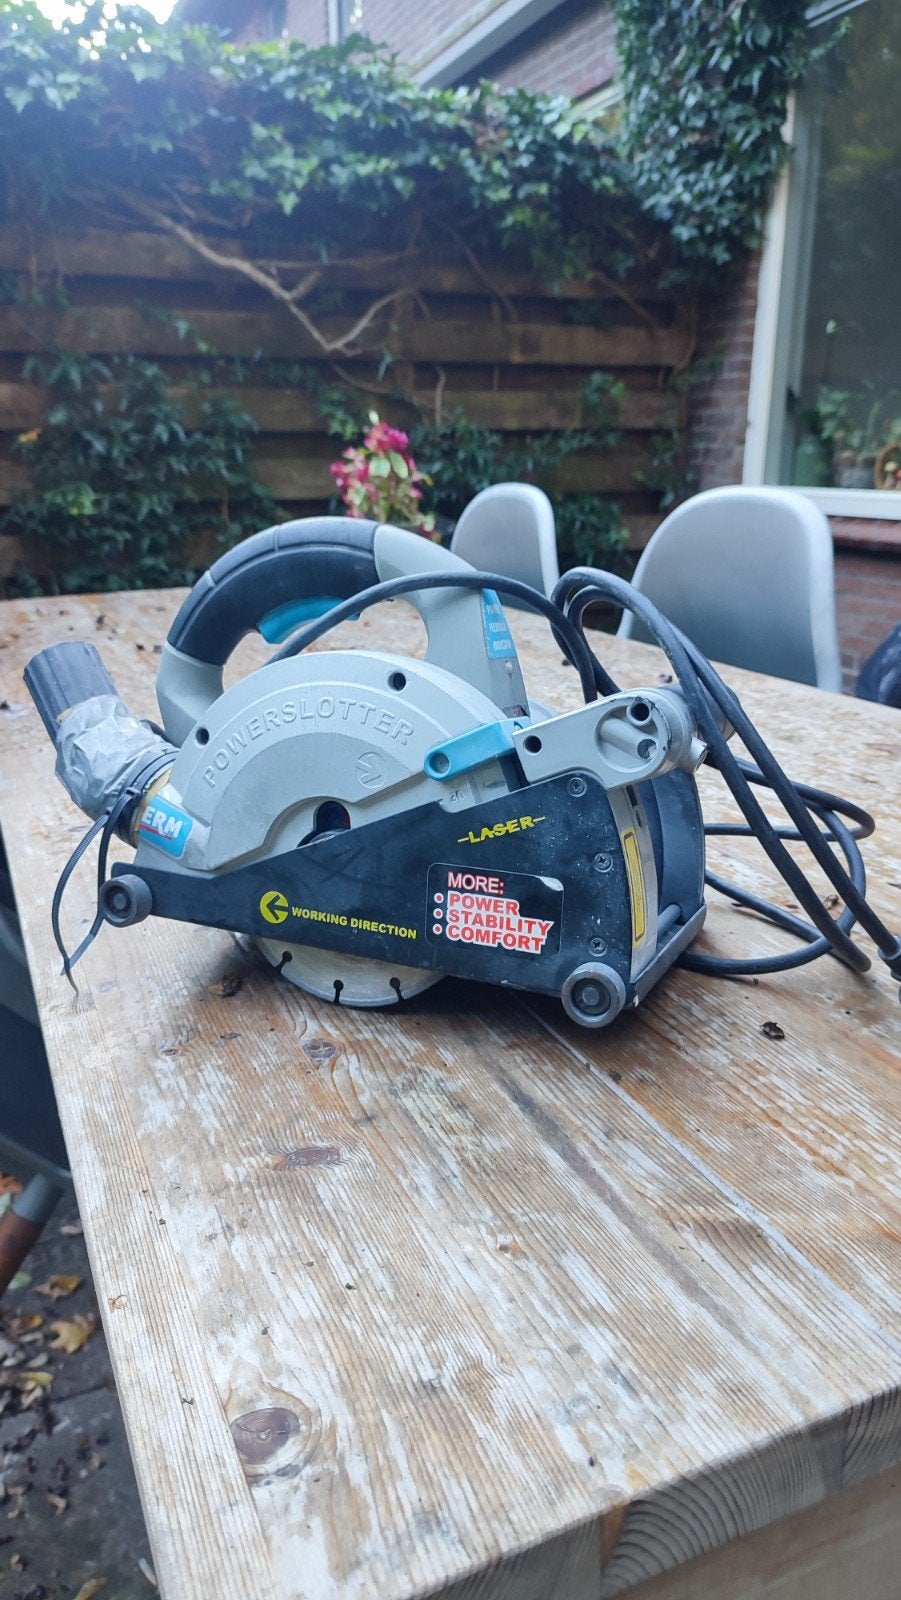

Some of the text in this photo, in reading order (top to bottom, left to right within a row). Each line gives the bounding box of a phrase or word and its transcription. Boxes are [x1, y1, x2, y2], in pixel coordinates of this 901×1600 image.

[202, 696, 414, 789] POWERSLOTTER
[141, 805, 184, 838] ERM
[468, 815, 535, 844] LASER
[447, 871, 505, 895] MORE:
[449, 892, 519, 917] POWER
[292, 906, 417, 940] WORKING DIRECTION
[448, 908, 552, 937] STABILITY
[447, 924, 544, 952] COMFORT
